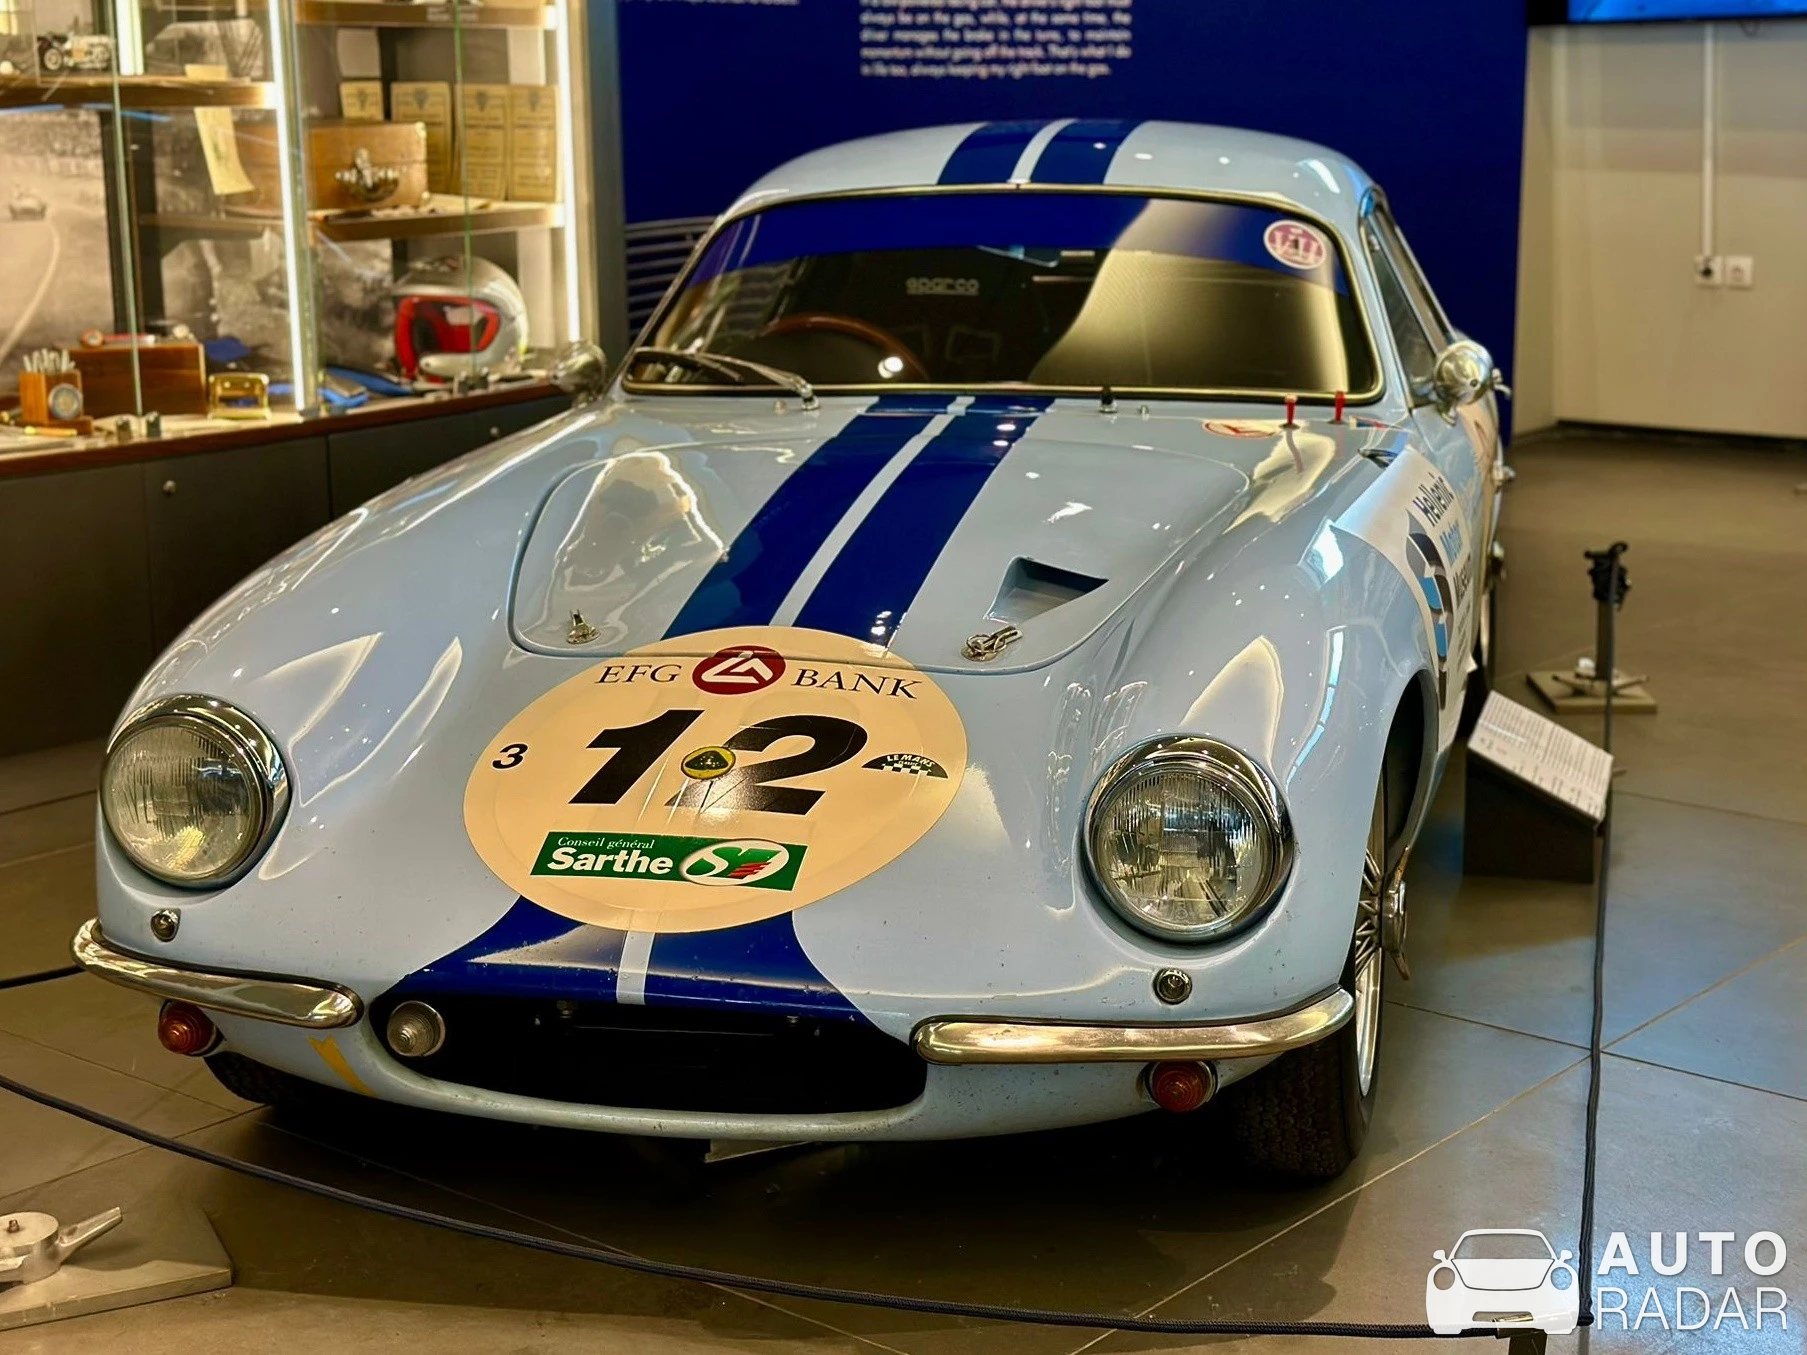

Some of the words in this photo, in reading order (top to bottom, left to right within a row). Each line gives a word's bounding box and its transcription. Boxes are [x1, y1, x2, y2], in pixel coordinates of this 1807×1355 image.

[595, 663, 682, 684] EFG
[790, 667, 922, 700] BANK
[492, 743, 529, 770] 3
[568, 709, 868, 816] 12
[557, 836, 605, 848] Conseil
[606, 838, 656, 850] général
[547, 847, 674, 874] Sarthe
